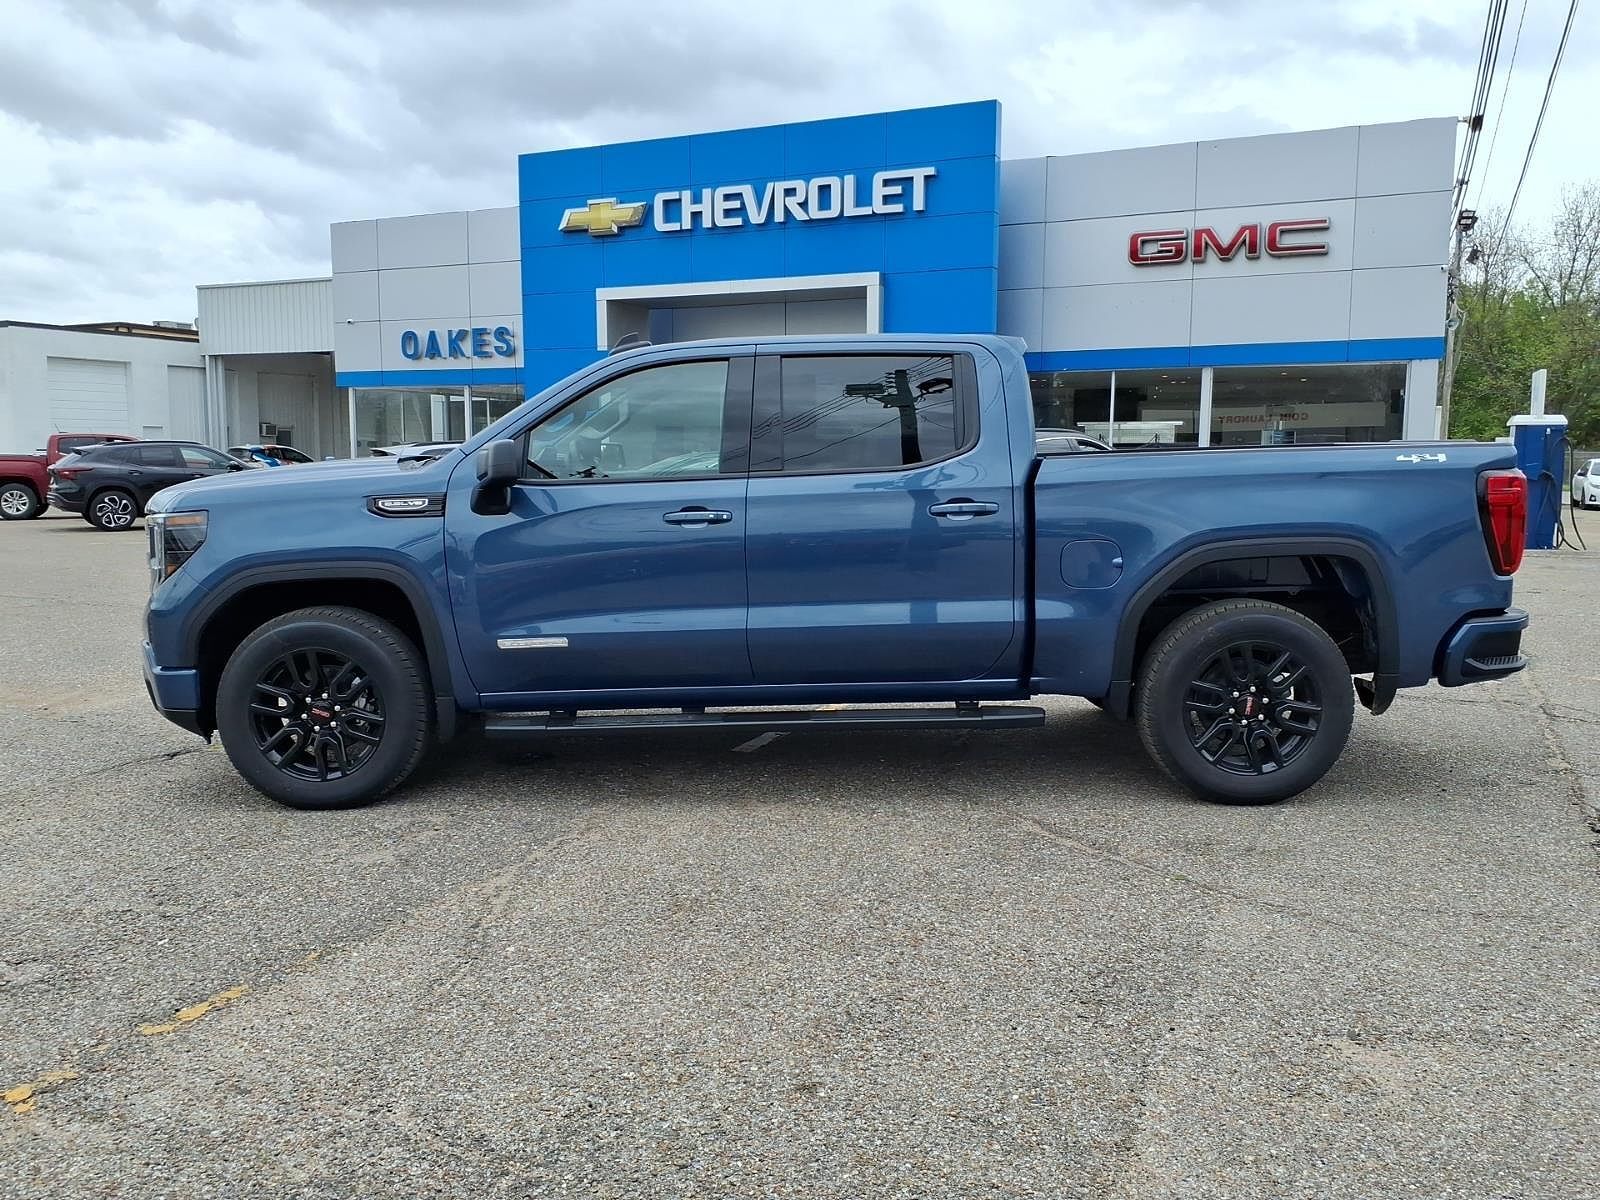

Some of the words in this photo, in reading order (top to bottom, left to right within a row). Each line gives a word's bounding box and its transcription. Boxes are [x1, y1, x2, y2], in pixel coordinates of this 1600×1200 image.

[653, 166, 936, 233] CHEVROLET
[1128, 217, 1330, 266] GMC
[400, 326, 516, 361] OAKES
